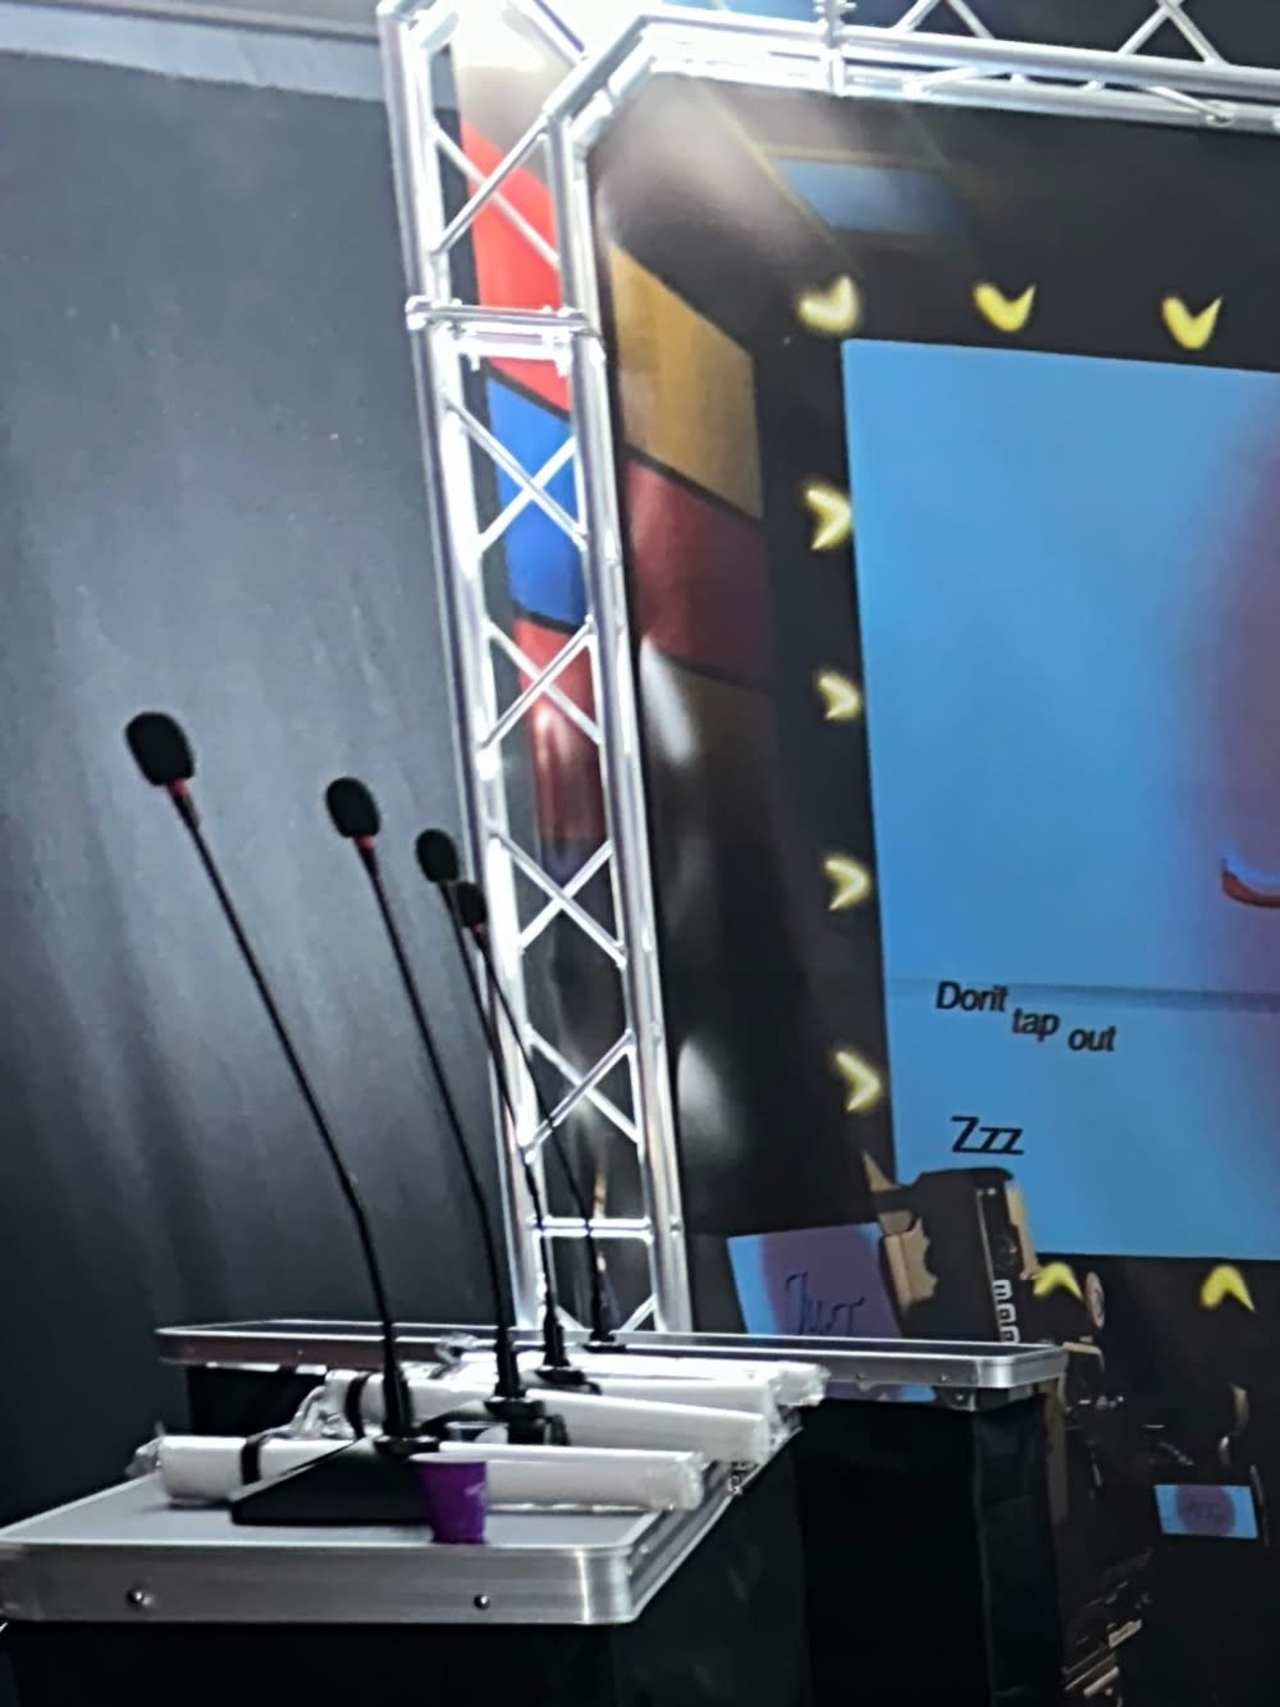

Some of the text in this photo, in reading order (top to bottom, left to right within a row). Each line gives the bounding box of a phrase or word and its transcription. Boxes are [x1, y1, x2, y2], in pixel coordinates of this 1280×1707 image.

[1012, 1007, 1061, 1042] tap
[1066, 1025, 1117, 1052] out
[950, 1114, 1025, 1156] Zzz
